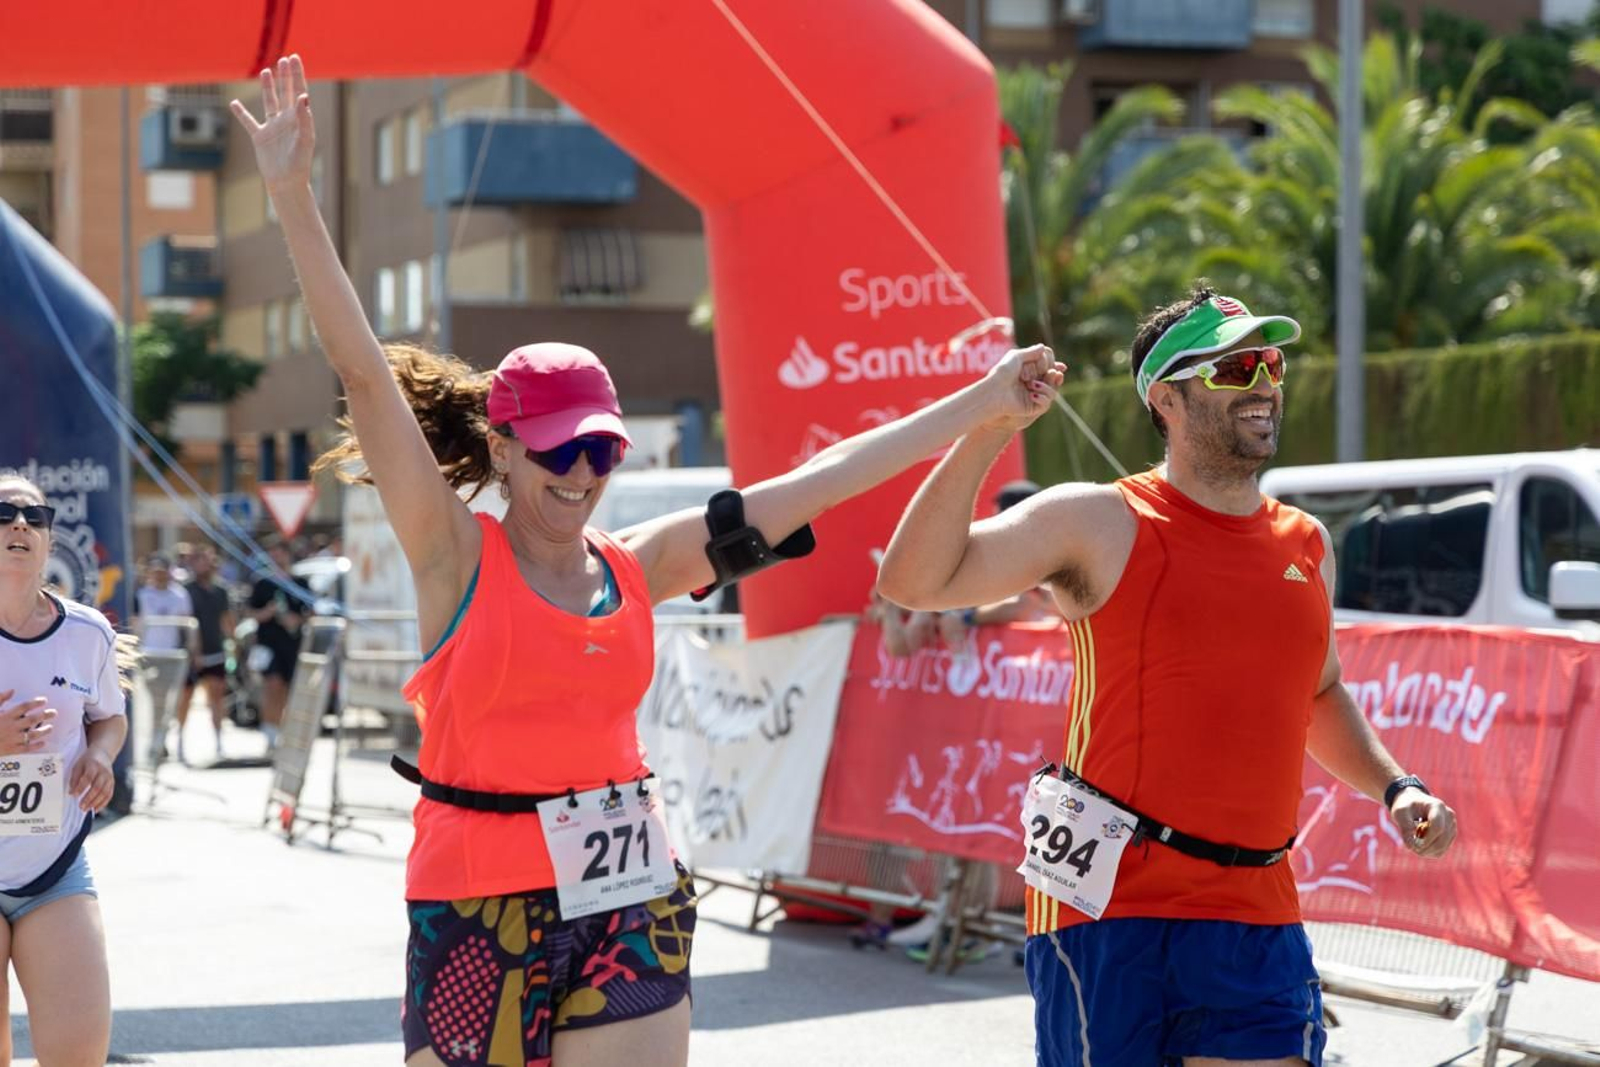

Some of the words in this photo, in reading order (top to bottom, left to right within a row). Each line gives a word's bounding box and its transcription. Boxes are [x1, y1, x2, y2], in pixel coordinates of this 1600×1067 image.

[839, 267, 970, 319] Sports
[0, 781, 43, 814] 90
[581, 819, 650, 882] 271
[1029, 814, 1100, 879] 294
